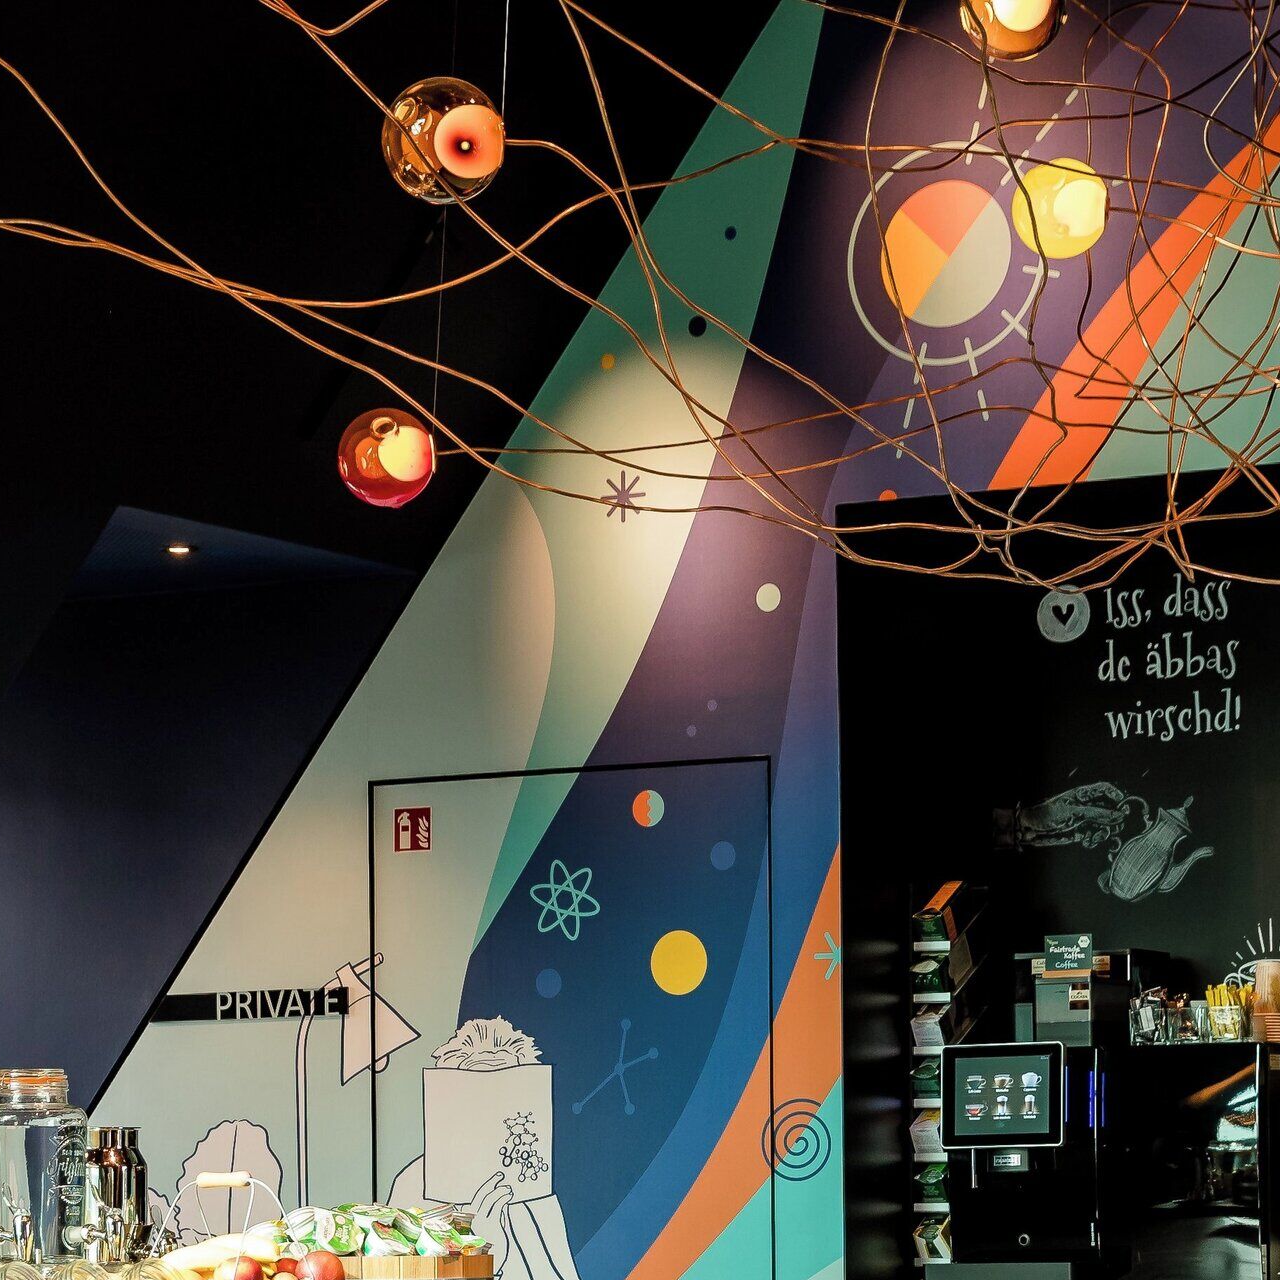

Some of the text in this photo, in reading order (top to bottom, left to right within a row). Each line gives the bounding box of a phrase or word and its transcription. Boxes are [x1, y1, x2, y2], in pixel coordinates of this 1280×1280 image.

[1103, 572, 1232, 629] Iss, dass
[1097, 631, 1240, 683] de äbbas
[1104, 687, 1241, 742] wirschd!
[1055, 960, 1078, 969] Coffee
[216, 988, 340, 1021] PRIVATE
